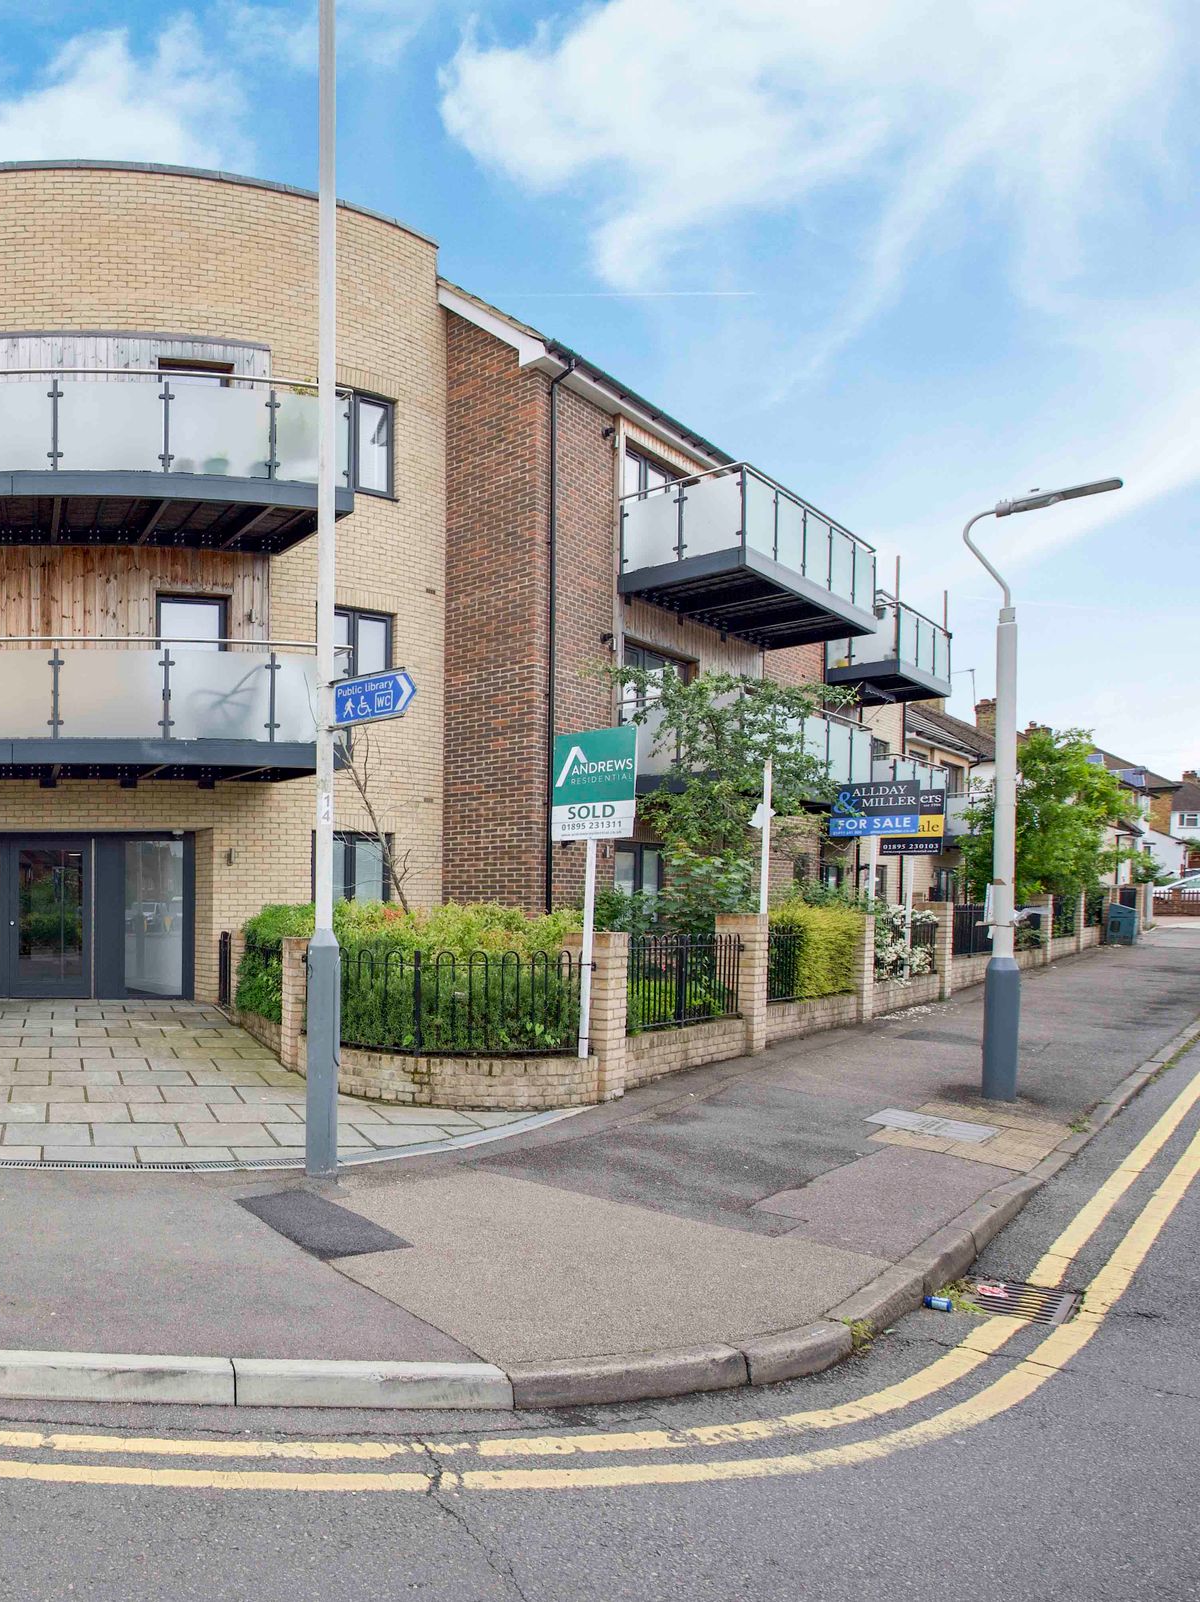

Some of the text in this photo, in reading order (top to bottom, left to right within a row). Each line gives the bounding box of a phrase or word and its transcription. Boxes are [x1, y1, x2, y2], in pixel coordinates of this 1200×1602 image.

[337, 680, 394, 698] Public library
[377, 695, 391, 708] WC
[571, 758, 633, 776] ANDREWS
[570, 773, 633, 785] RESIDENTIAL
[852, 785, 908, 797] ALLDAY
[833, 791, 917, 814] & MILLER
[920, 794, 942, 804] ers
[568, 804, 615, 820] SOLD
[561, 820, 622, 831] 01895 231311
[838, 817, 911, 830] FOR SALE
[918, 820, 940, 833] ale
